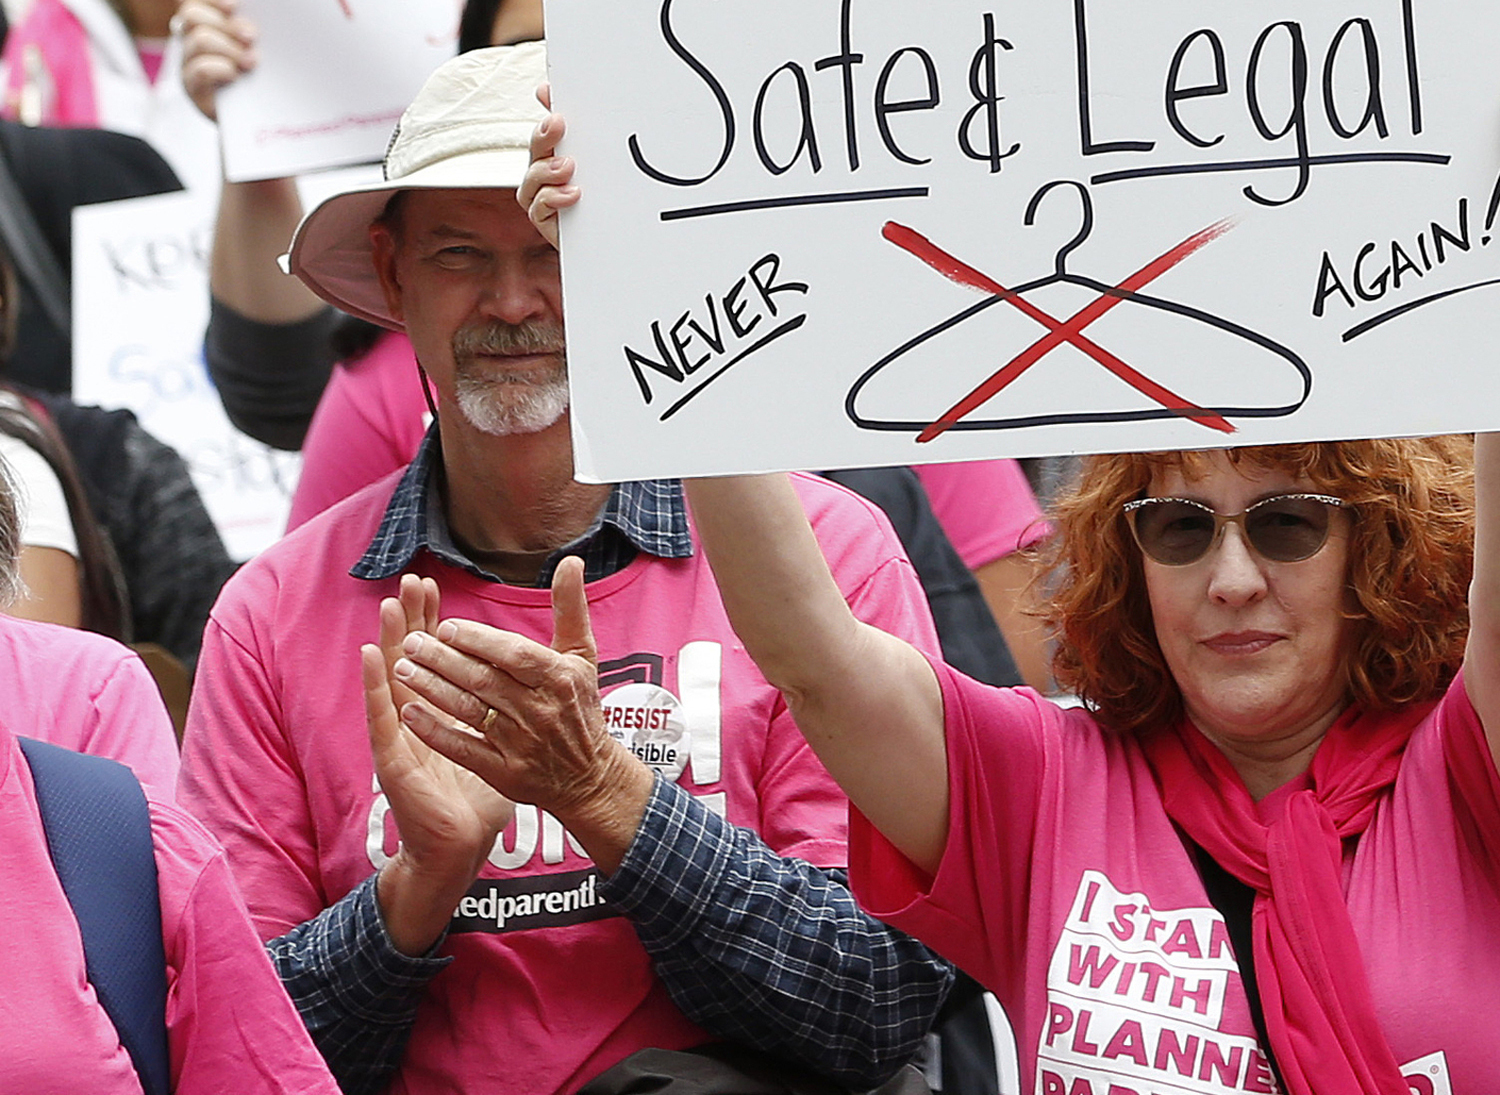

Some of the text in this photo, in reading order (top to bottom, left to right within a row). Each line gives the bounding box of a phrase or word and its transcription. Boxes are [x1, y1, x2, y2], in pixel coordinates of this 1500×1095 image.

[957, 12, 1021, 174] &
[624, 254, 809, 403] NEVER
[1079, 881, 1101, 923] I
[1067, 943, 1213, 1016] WITH
[1046, 1002, 1275, 1094] PLANNE
